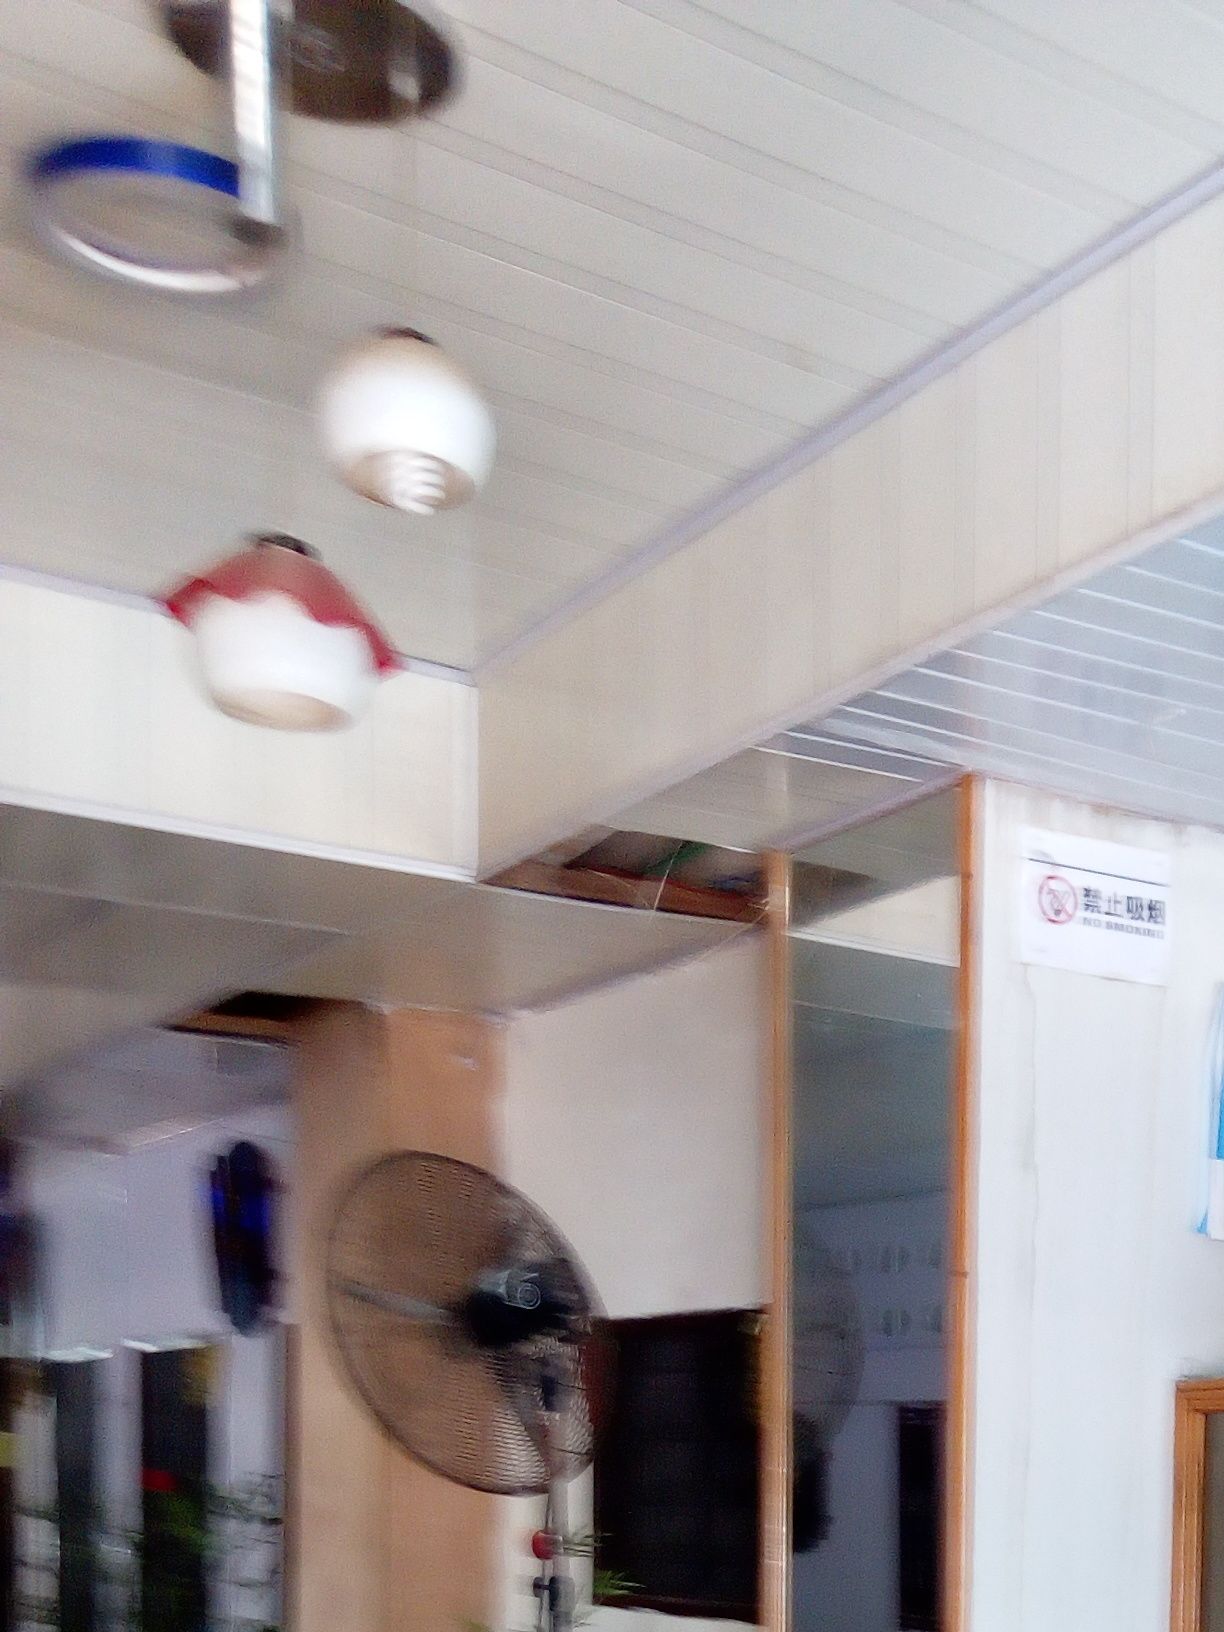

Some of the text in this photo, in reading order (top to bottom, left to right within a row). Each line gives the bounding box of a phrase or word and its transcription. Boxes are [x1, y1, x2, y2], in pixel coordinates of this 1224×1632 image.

[1083, 887, 1166, 925] 禁止吸烟
[1083, 917, 1165, 940] NO SMOKING
